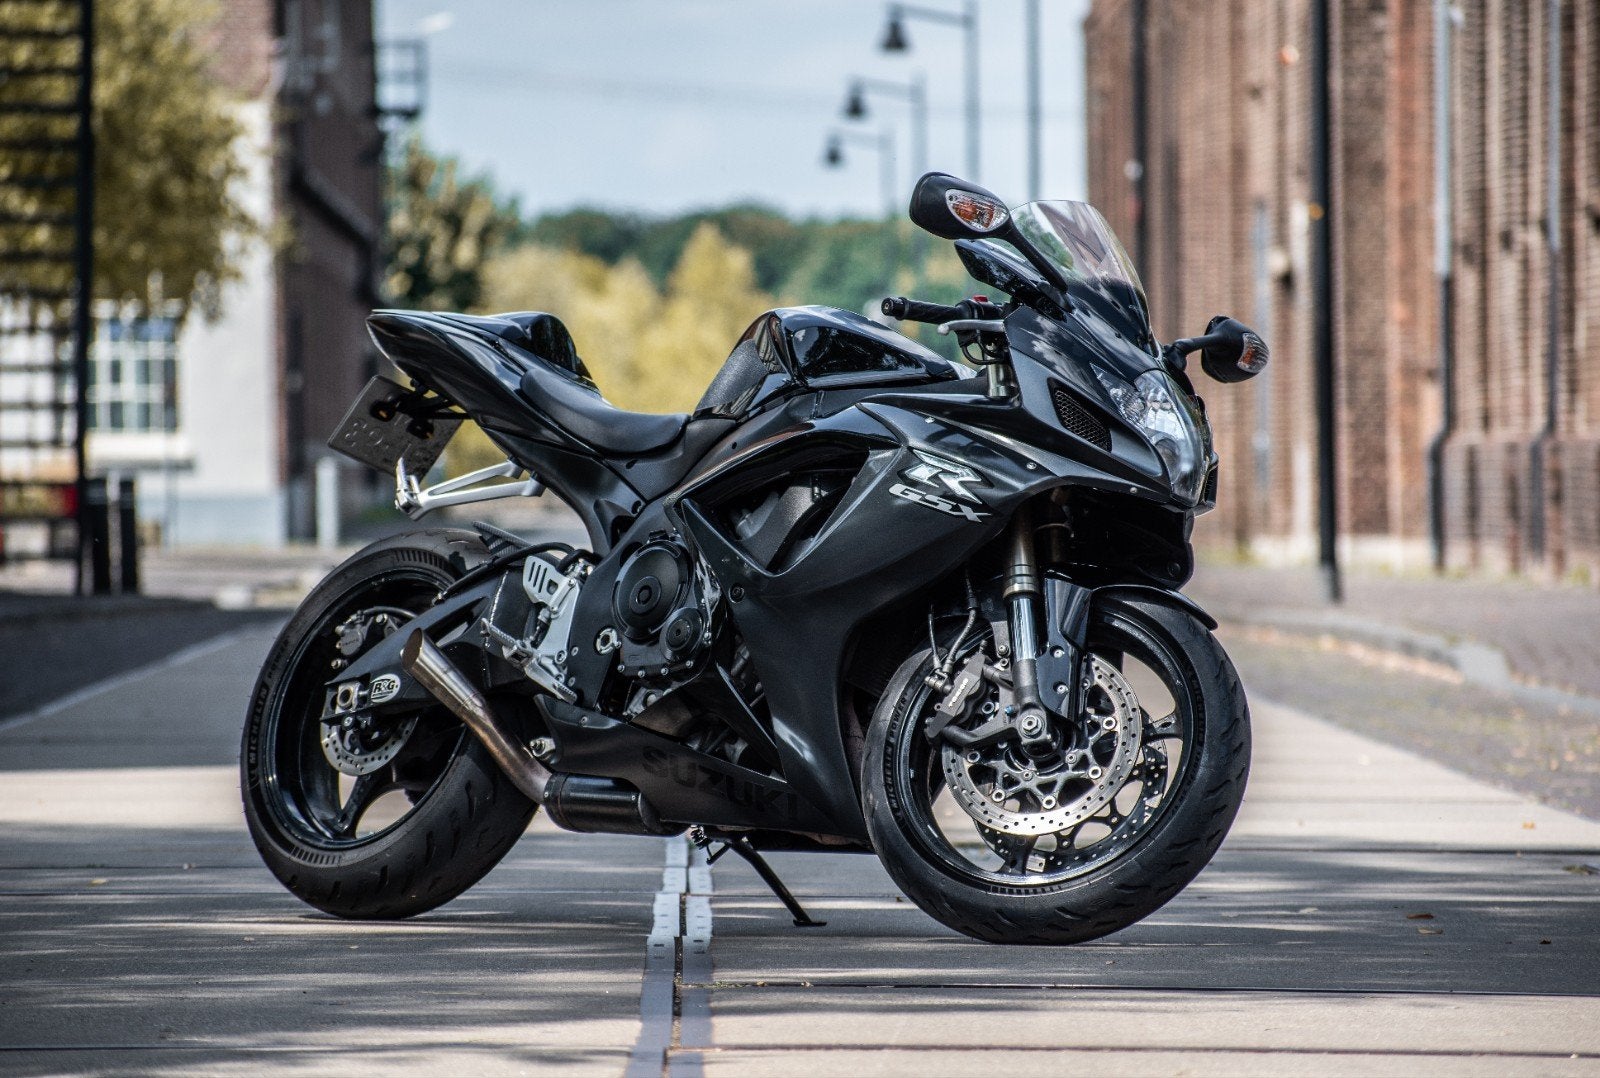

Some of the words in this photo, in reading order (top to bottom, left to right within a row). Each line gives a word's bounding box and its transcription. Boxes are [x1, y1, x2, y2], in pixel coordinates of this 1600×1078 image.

[888, 483, 992, 523] GSX
[373, 680, 396, 693] R&G
[249, 688, 268, 764] MICHELIN
[889, 697, 907, 738] POWER
[642, 745, 798, 820] SUZUKI
[885, 745, 898, 809] MICHELIN
